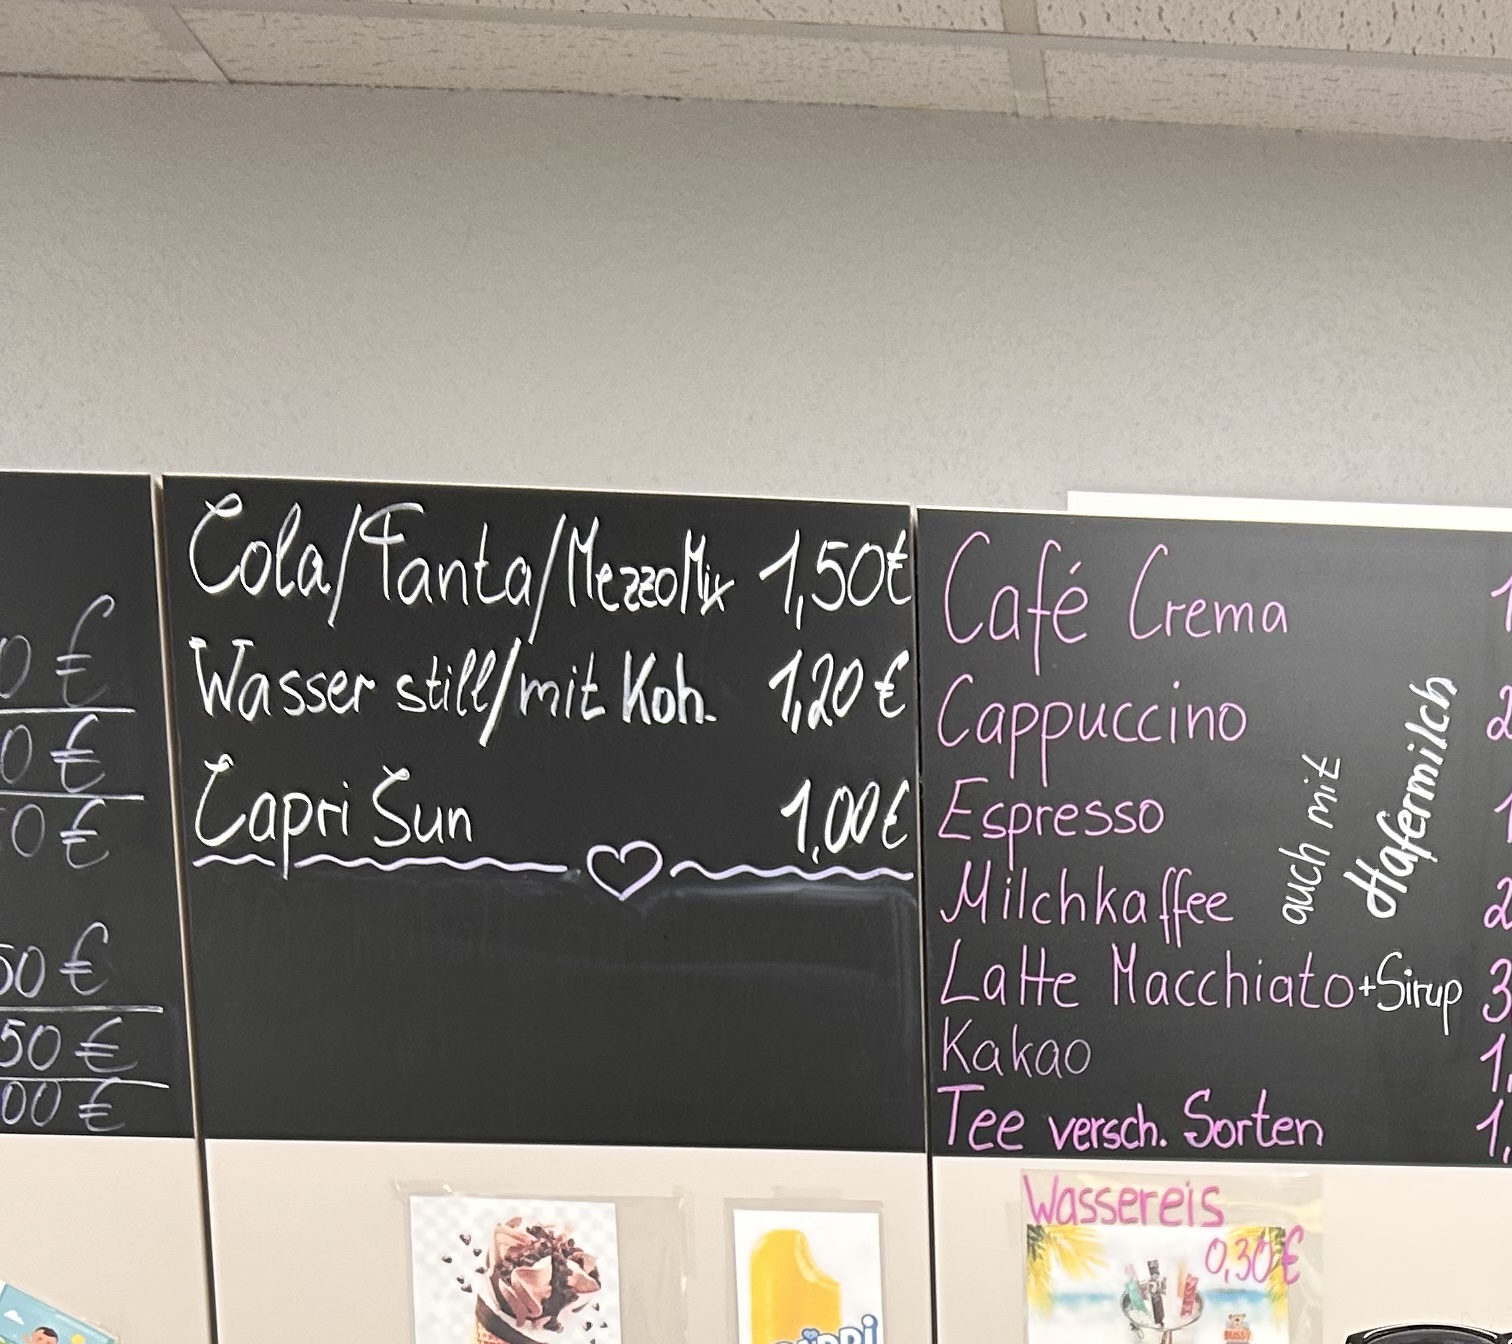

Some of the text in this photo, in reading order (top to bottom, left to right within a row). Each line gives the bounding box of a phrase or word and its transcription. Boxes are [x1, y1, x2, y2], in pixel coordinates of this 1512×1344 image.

[944, 531, 1089, 676] Café
[1129, 544, 1288, 640] Crema
[189, 635, 376, 722] Wasser
[621, 650, 717, 724] Koh.
[937, 674, 1248, 788] Cappuccino
[194, 753, 350, 881] Capri
[371, 766, 474, 846] Sun
[938, 777, 1165, 870] Espresso
[1279, 754, 1342, 925] auch mit
[1343, 675, 1458, 919] Hafermilch
[939, 860, 1235, 949] Milchkaffee
[940, 939, 1080, 1009] Latte
[942, 1016, 1092, 1079] Kakao
[937, 1084, 1026, 1151] Tee
[1049, 1103, 1168, 1151] versch.
[1183, 1089, 1323, 1149] Sorten
[1023, 1174, 1226, 1228] Wassereis
